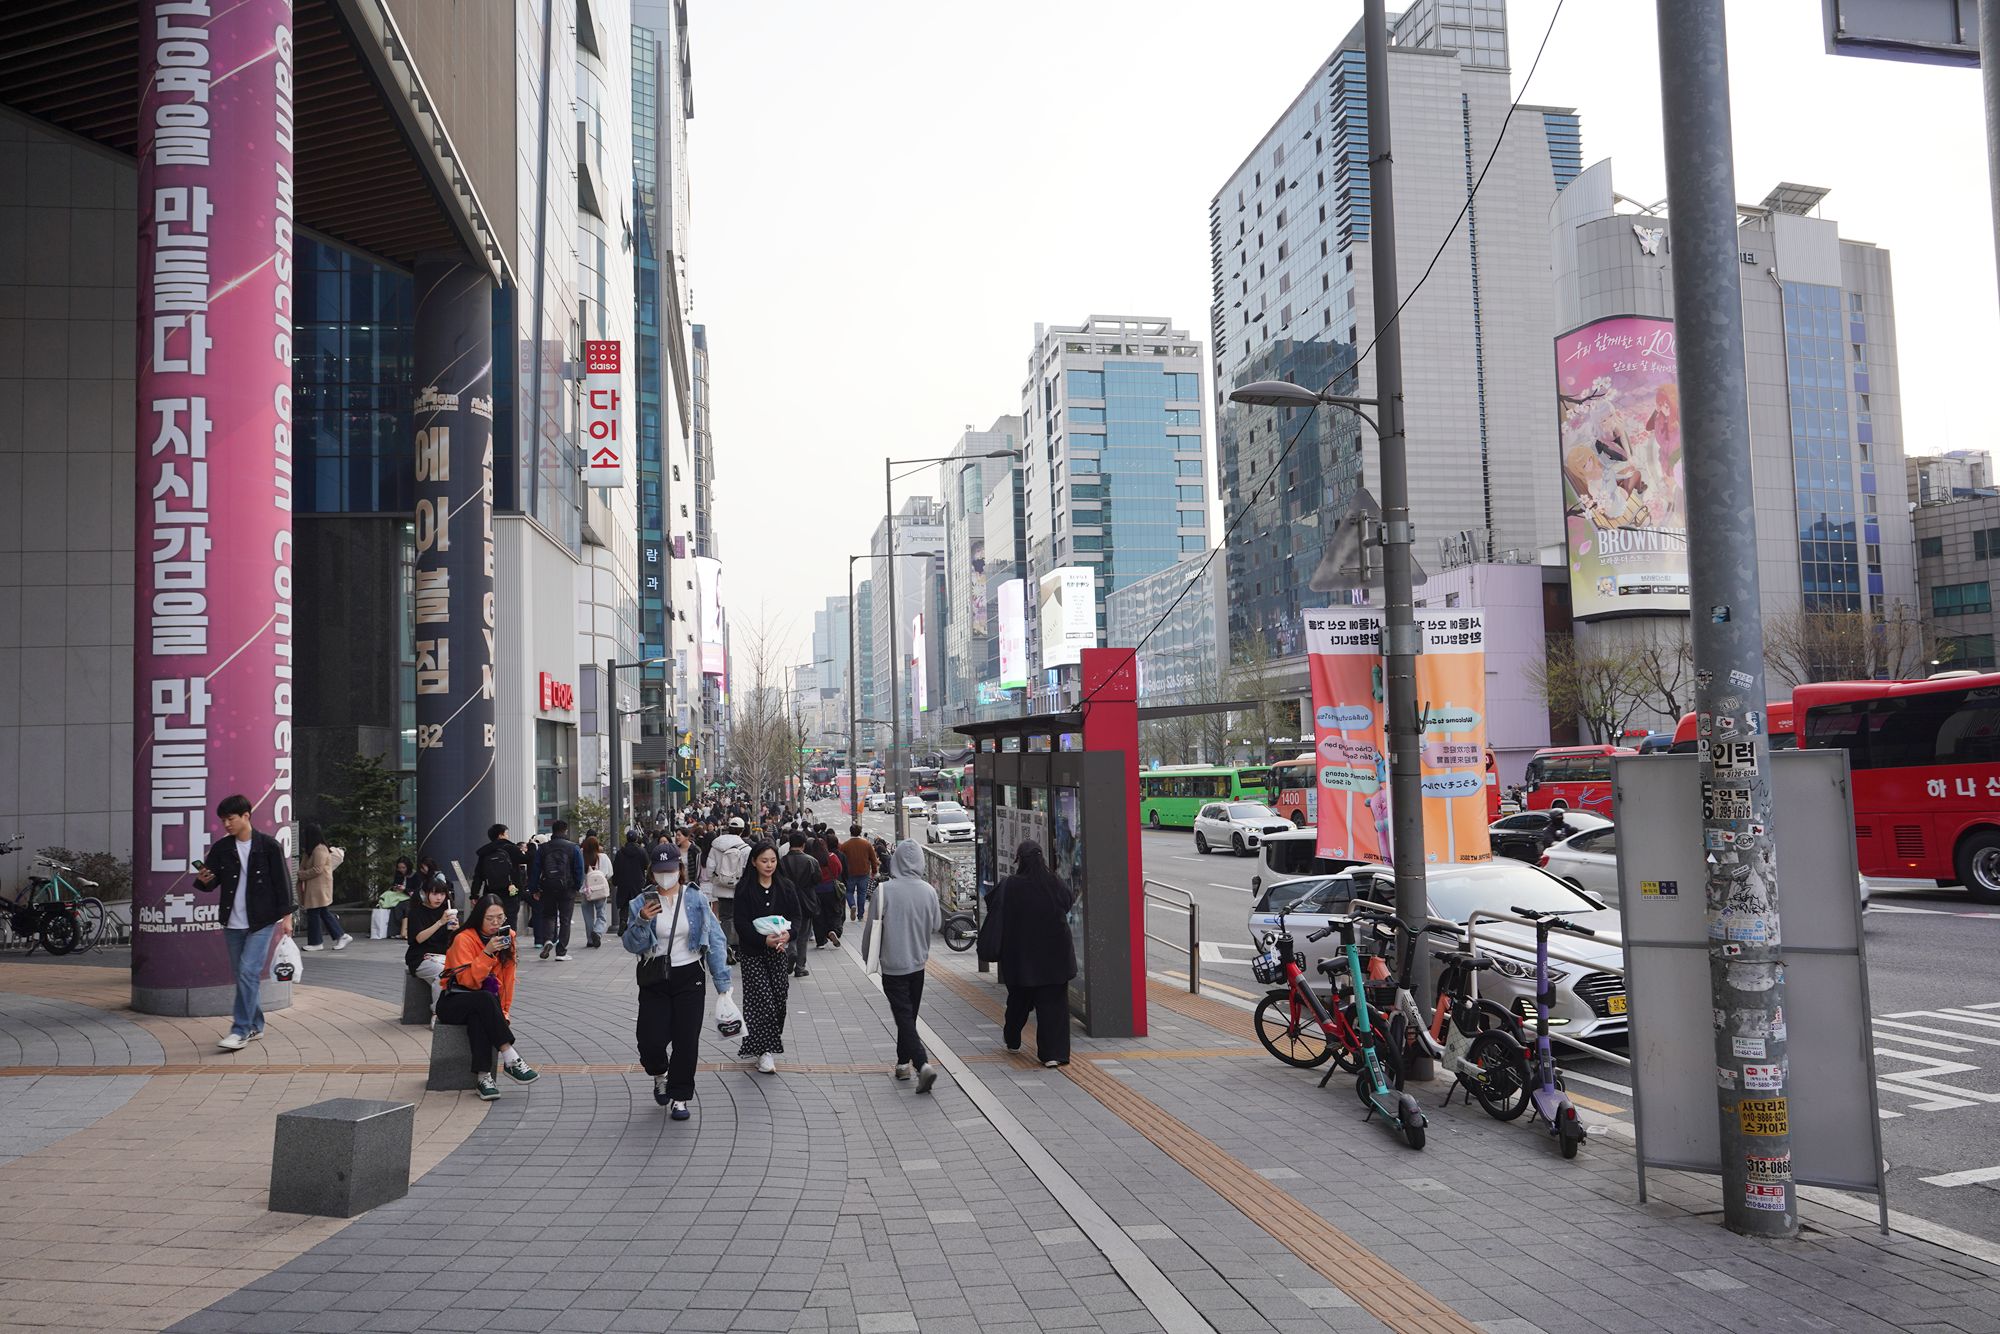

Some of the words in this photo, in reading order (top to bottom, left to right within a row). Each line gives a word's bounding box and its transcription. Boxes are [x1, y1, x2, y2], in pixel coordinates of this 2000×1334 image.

[154, 186, 213, 375] 만들다
[590, 362, 616, 370] daiso
[589, 389, 621, 469] 다이소
[151, 397, 213, 655] 자신감을
[1598, 527, 1658, 554] BROWN
[415, 427, 450, 694] 에이블짐
[418, 723, 444, 748] B2
[1712, 742, 1755, 769] 인력
[150, 677, 213, 873] 만들다
[1281, 792, 1300, 805] 1400
[138, 923, 178, 933] PREMIUM
[139, 906, 164, 924] Able
[1743, 1100, 1786, 1112] 사다리차
[1744, 1121, 1787, 1133] 스카이차
